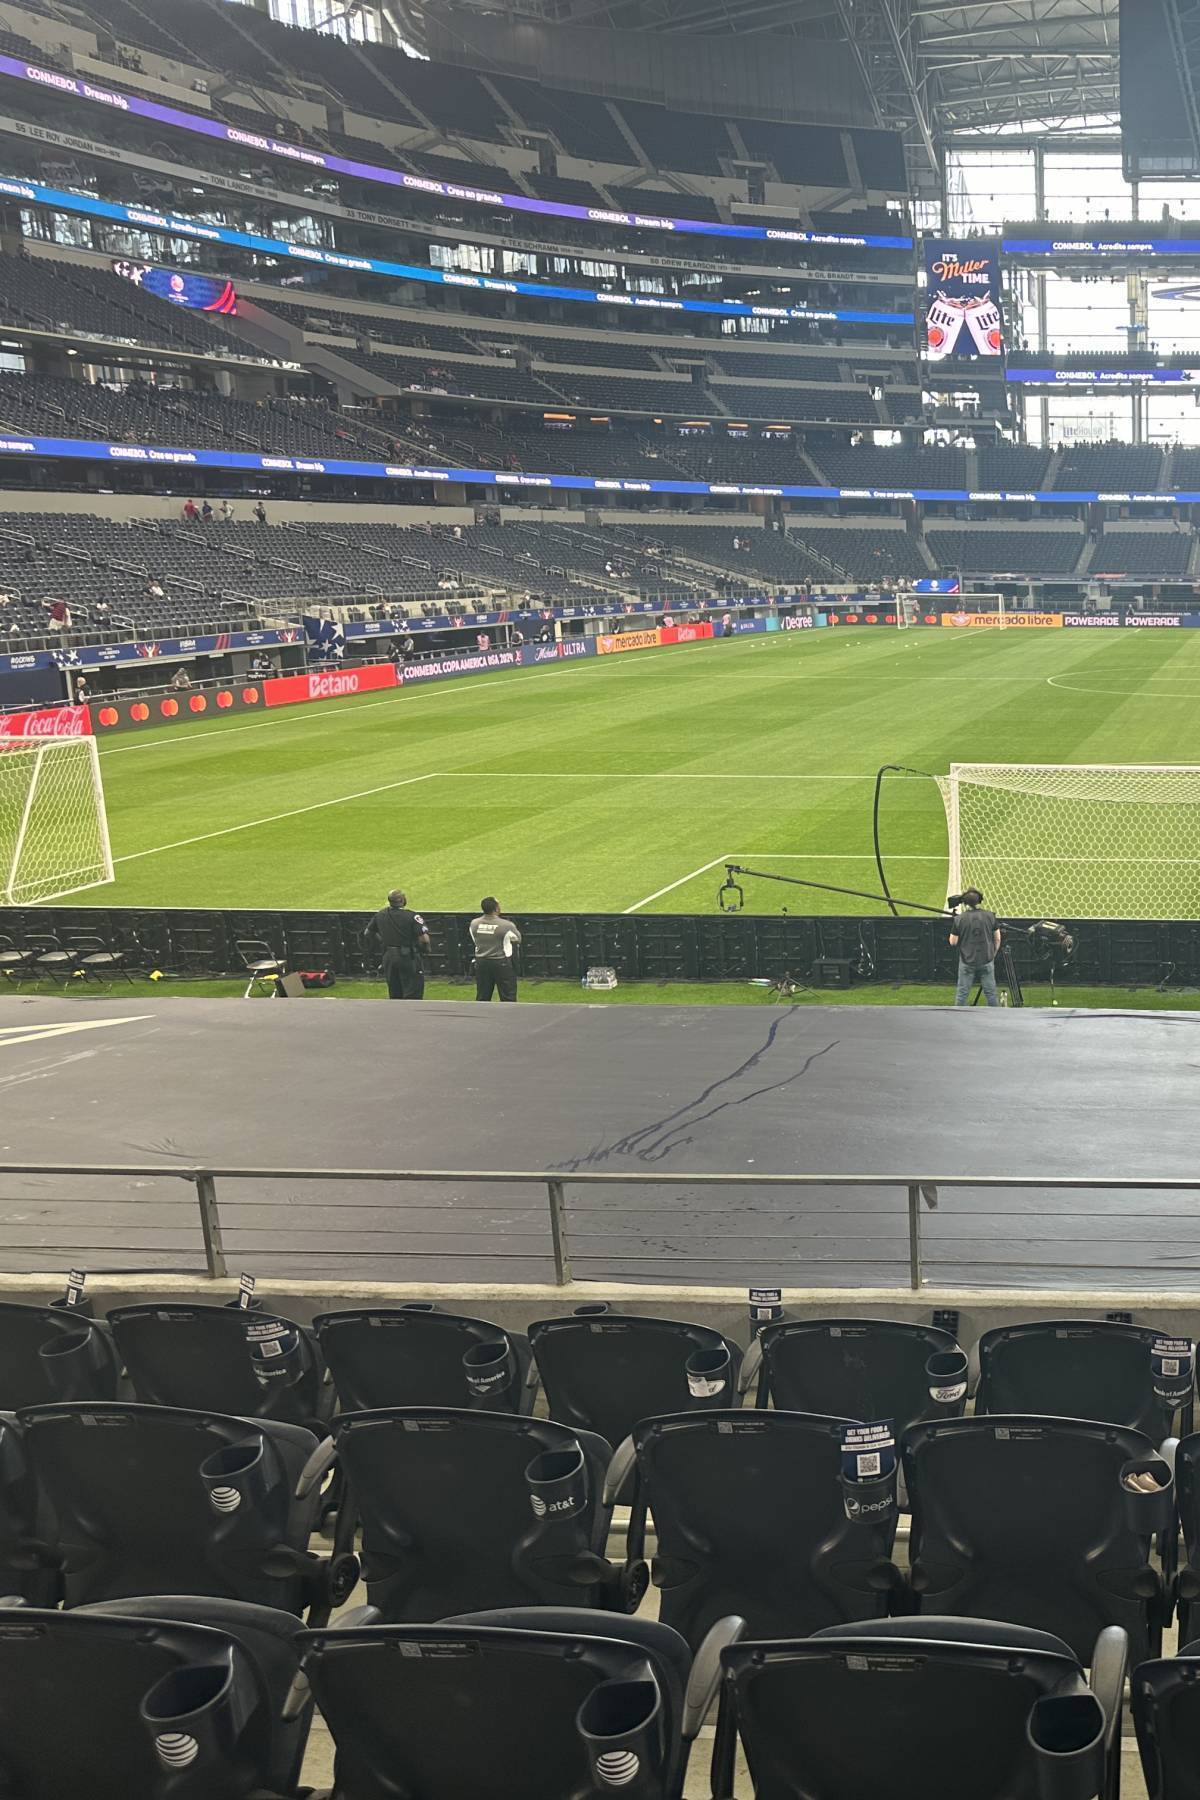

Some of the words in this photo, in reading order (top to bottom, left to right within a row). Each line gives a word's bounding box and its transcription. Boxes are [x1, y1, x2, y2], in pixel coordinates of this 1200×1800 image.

[27, 67, 80, 93] CONMEBOL
[84, 86, 113, 102] Dream
[113, 94, 130, 110] big.
[29, 126, 46, 139] LEE
[63, 135, 94, 151] JORDAN
[227, 129, 270, 149] CONMEBOL
[0, 182, 21, 194] ream
[403, 176, 444, 193] CONMEBOL
[127, 211, 169, 227] CONMEBOL
[358, 212, 375, 221] TONY
[588, 210, 631, 223] CONMEBOL
[635, 217, 660, 227] Dream
[767, 230, 808, 241] CONMEBOL
[1052, 242, 1095, 250] CONMEBOL
[942, 254, 958, 262] IT'S
[932, 260, 989, 282] Miller
[962, 273, 991, 284] TIME
[752, 306, 789, 316] CONMEBOL
[930, 307, 955, 326] Lite
[976, 311, 1000, 330] Lite
[786, 616, 813, 630] Degree
[975, 615, 1024, 625] mercado
[1028, 615, 1053, 625] libre
[1065, 617, 1119, 625] POWERADE
[1125, 617, 1180, 626] POWERADE
[616, 634, 643, 649] mercado
[643, 632, 656, 645] libre
[678, 628, 696, 641] Betano
[563, 642, 586, 656] ULTRA
[404, 662, 442, 679] CONMEBOL
[443, 660, 460, 672] COPA
[487, 654, 499, 665] USA
[500, 653, 514, 663] 2024
[309, 674, 358, 698] Betano
[23, 707, 84, 736] Coca-Cola
[936, 1388, 960, 1399] Ford
[549, 1496, 575, 1512] at&t
